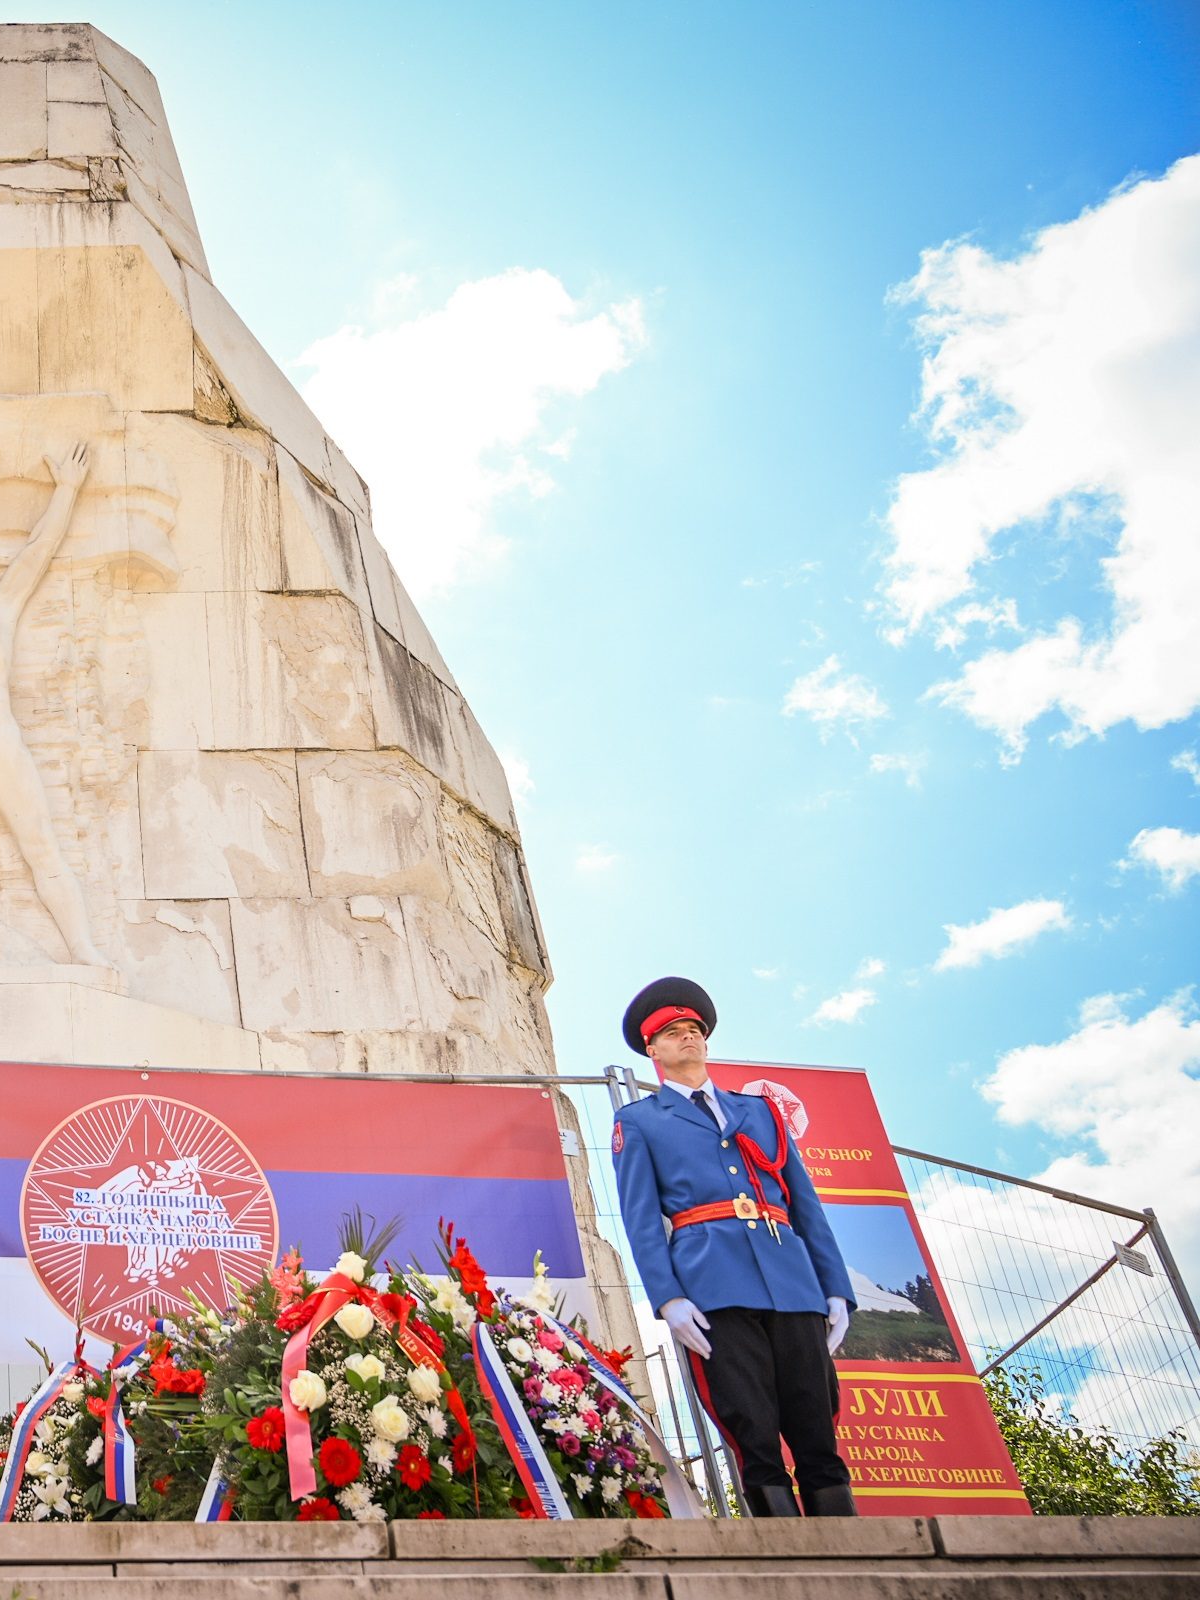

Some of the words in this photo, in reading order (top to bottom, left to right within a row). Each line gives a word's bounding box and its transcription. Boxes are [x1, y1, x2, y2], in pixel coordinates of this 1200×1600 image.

[805, 1147, 874, 1161] СУБНОР
[806, 1166, 832, 1178] ука
[75, 1192, 95, 1204] 82.
[101, 1192, 225, 1212] ГОДИШЊИЦА
[69, 1209, 154, 1225] УСТАНКА
[160, 1213, 233, 1231] НАРОДА
[42, 1227, 104, 1243] БОСНЕ
[109, 1230, 122, 1244] И
[126, 1231, 260, 1251] ХЕРЦЕГОВИНЕ
[850, 1387, 948, 1418] ЈУЛИ
[854, 1425, 945, 1442] УСТАНКА
[846, 1446, 925, 1464] НАРОДА
[848, 1467, 863, 1481] И
[865, 1467, 1007, 1486] ХЕРЦЕГОВИНЕ
